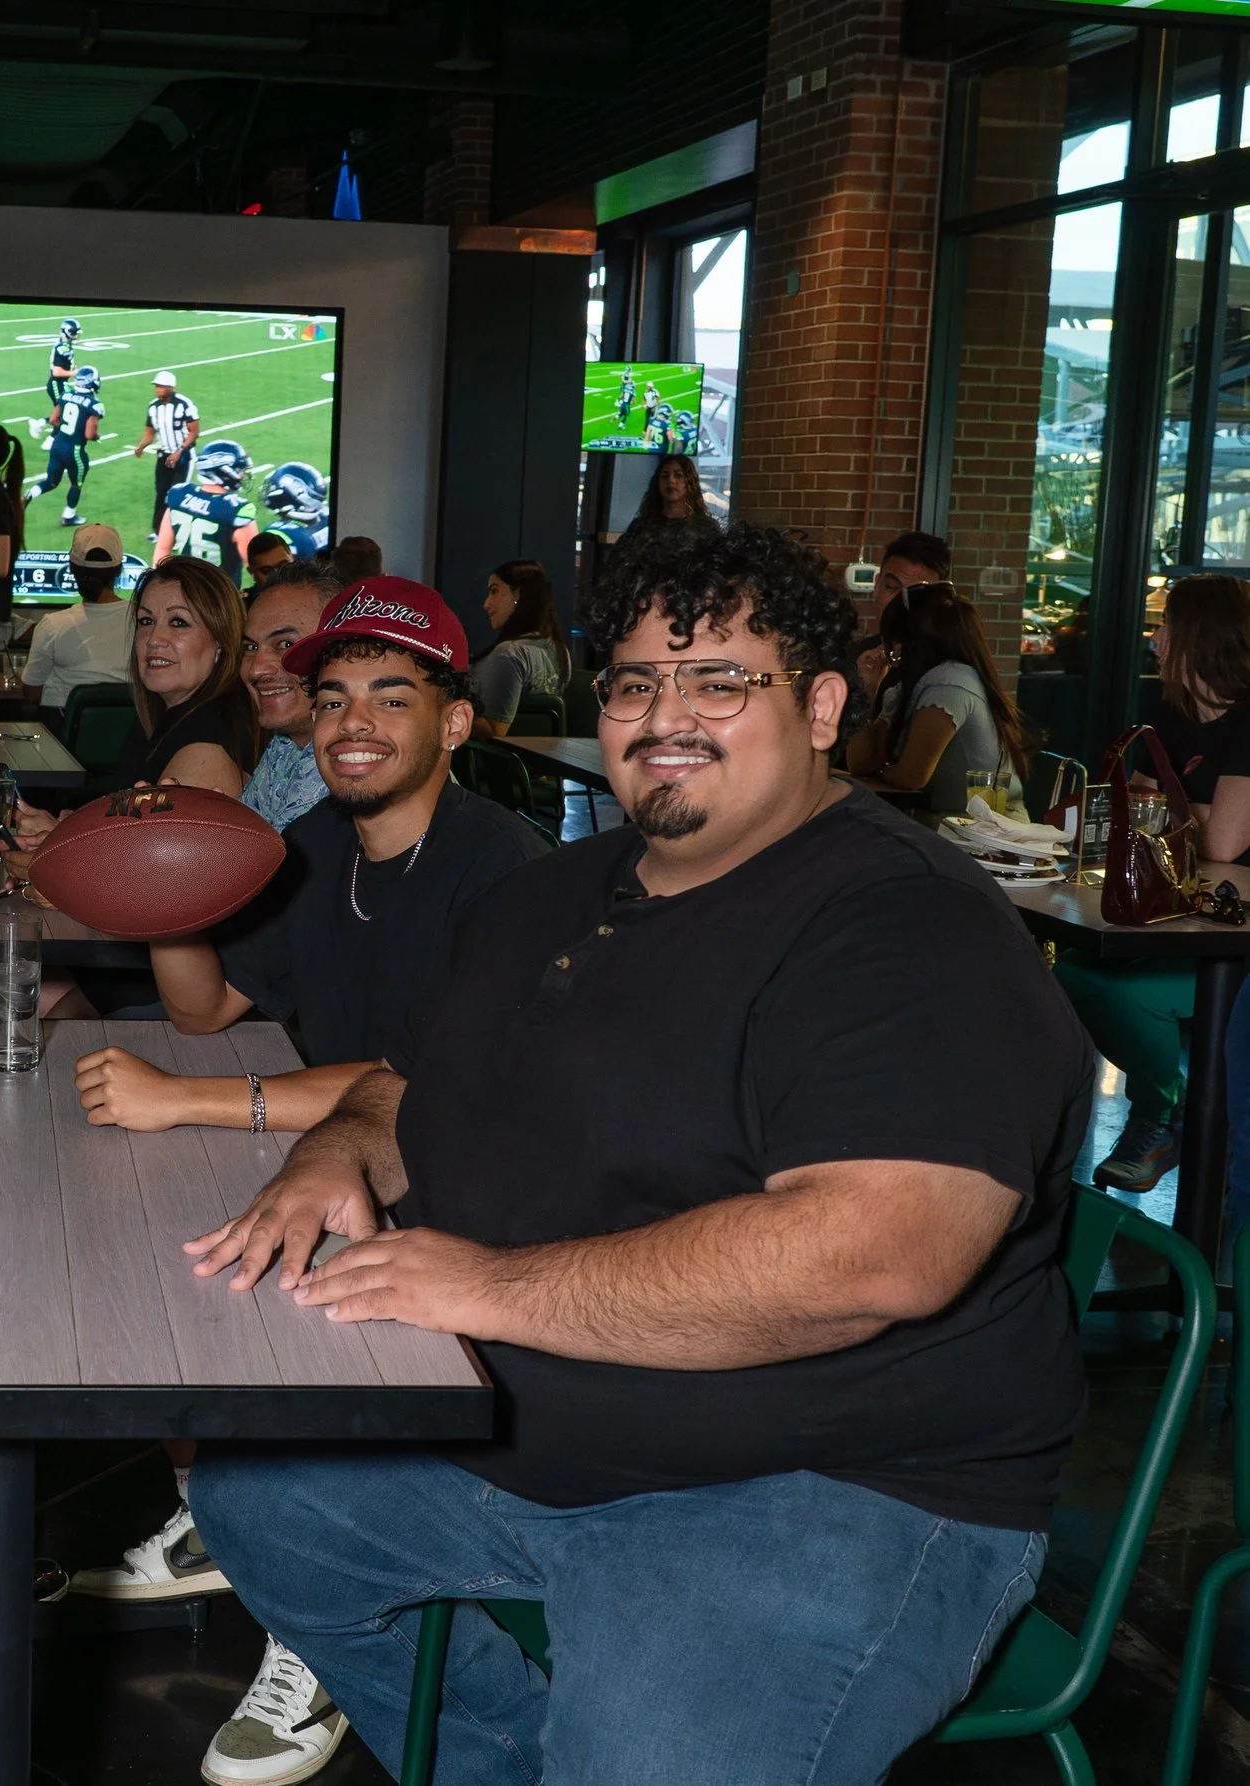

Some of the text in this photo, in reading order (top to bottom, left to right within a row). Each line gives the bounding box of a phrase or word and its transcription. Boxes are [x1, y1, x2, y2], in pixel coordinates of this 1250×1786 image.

[269, 323, 297, 340] LX
[60, 401, 79, 436] 9
[169, 509, 223, 567] 76
[32, 569, 45, 583] 6
[324, 586, 431, 630] Arizona
[105, 786, 175, 819] NFL
